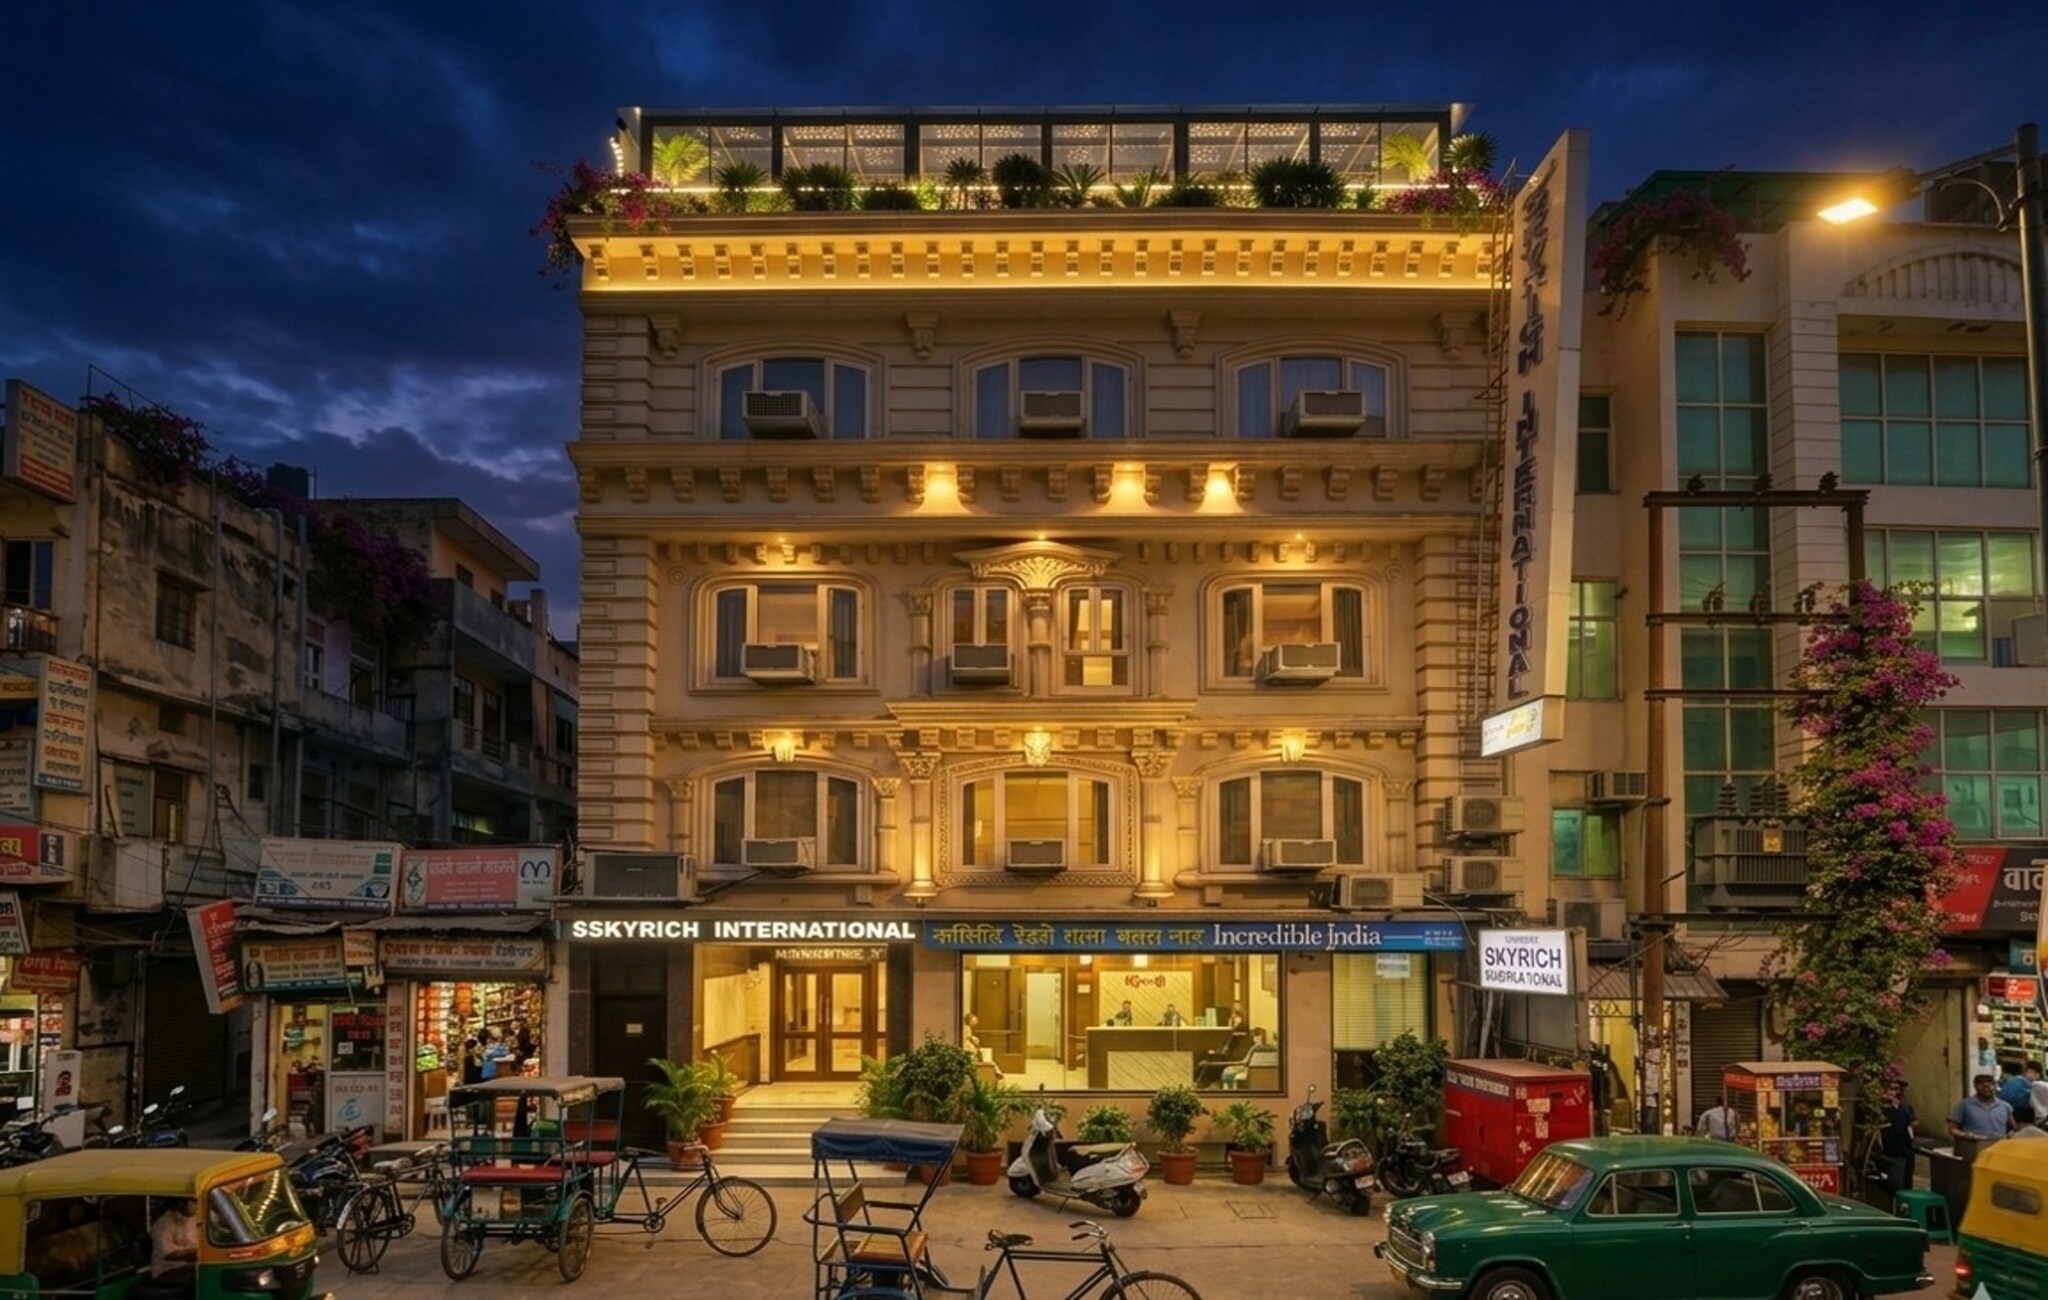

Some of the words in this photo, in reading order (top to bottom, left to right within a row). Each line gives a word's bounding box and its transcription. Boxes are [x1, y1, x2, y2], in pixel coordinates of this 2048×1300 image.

[572, 920, 699, 939] SSKYRICH
[714, 920, 916, 939] INTERNATIONAL
[1213, 924, 1323, 946] Incredible
[1485, 947, 1562, 970] SKYRICH
